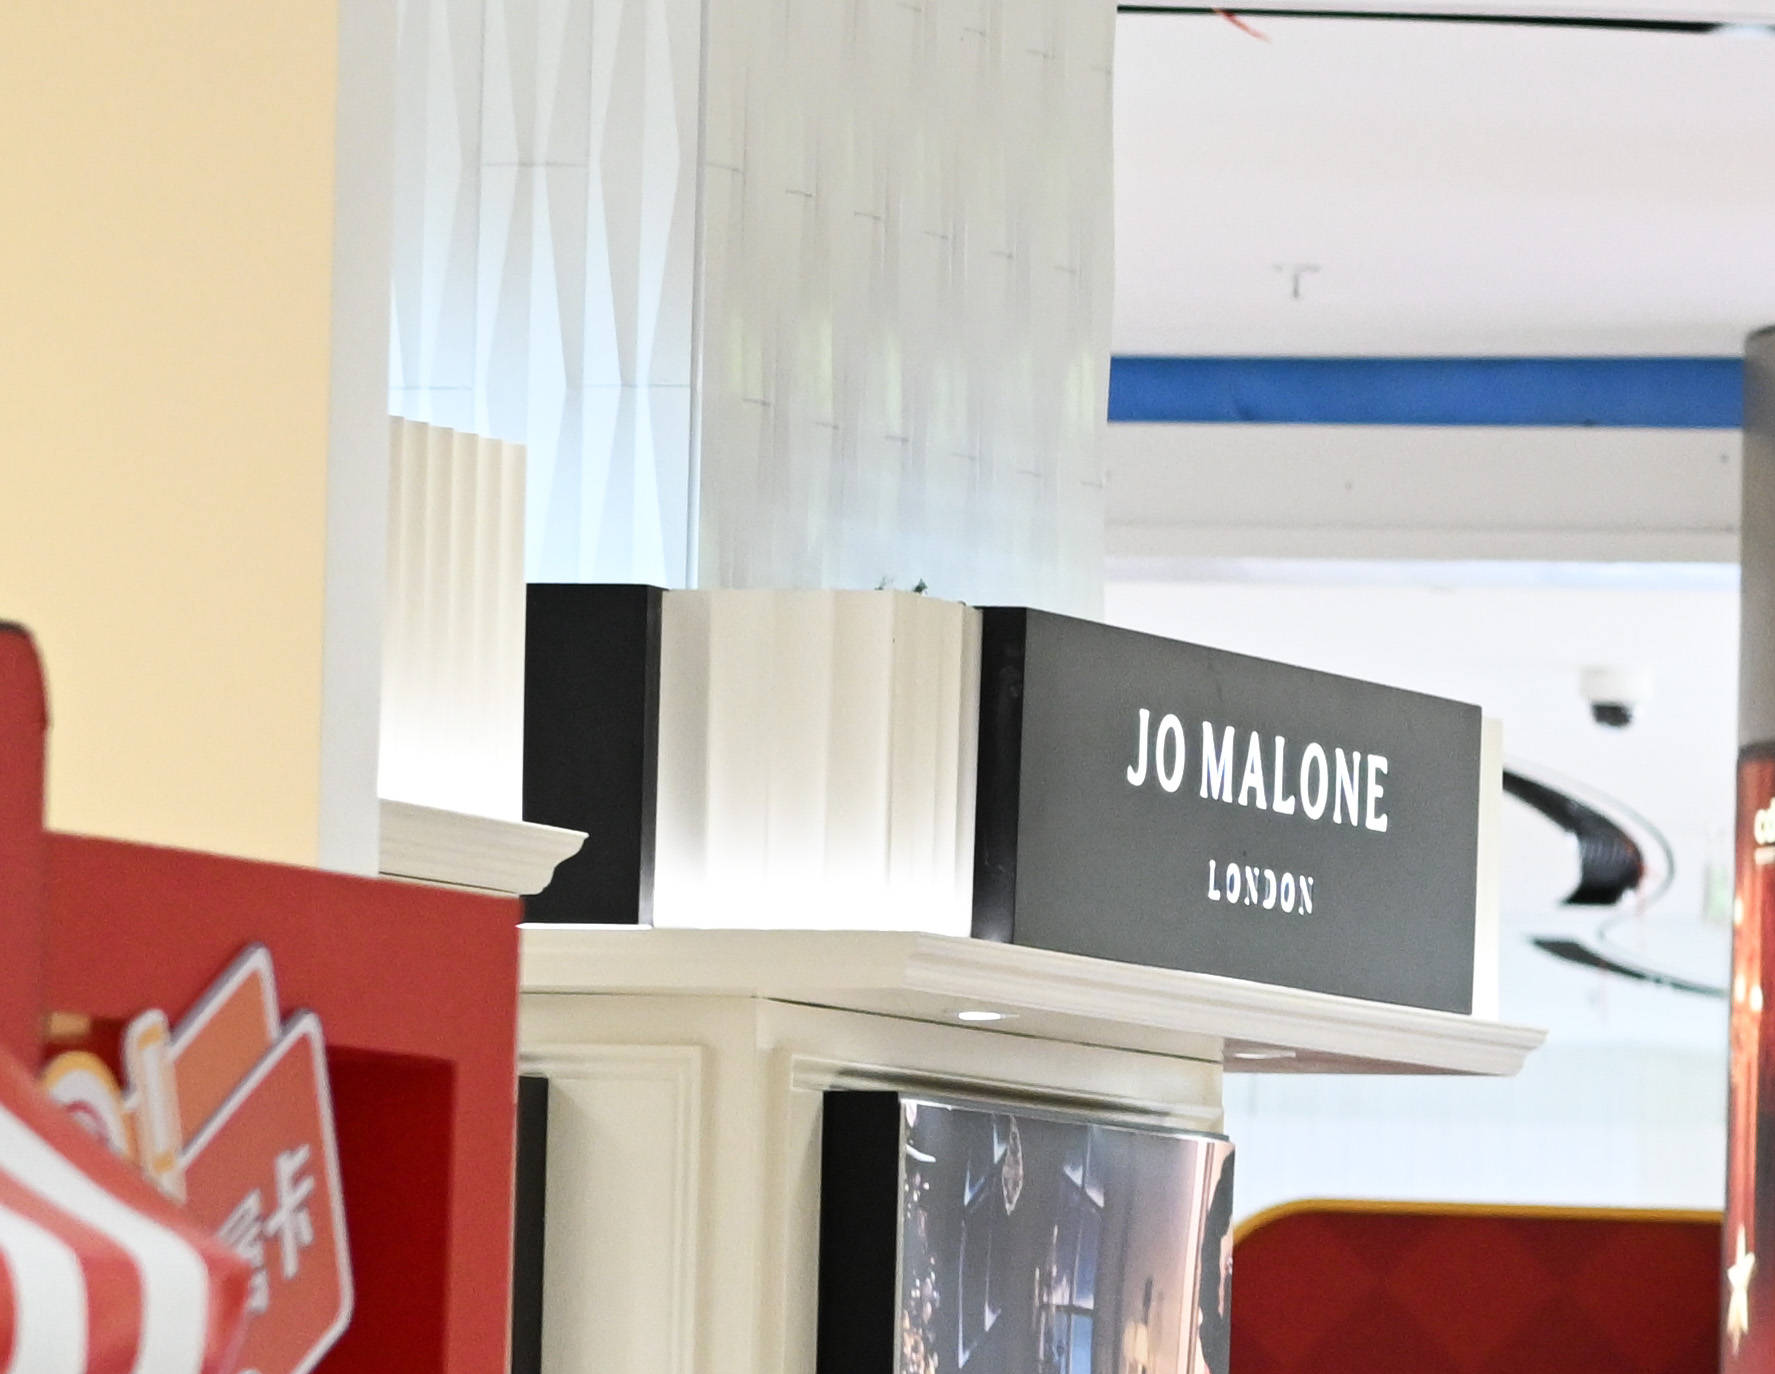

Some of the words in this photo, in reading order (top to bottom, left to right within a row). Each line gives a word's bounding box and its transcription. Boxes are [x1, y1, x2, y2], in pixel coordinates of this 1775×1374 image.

[1126, 708, 1186, 793] JO
[1200, 720, 1388, 833] MALONE
[1207, 858, 1315, 916] LONDON
